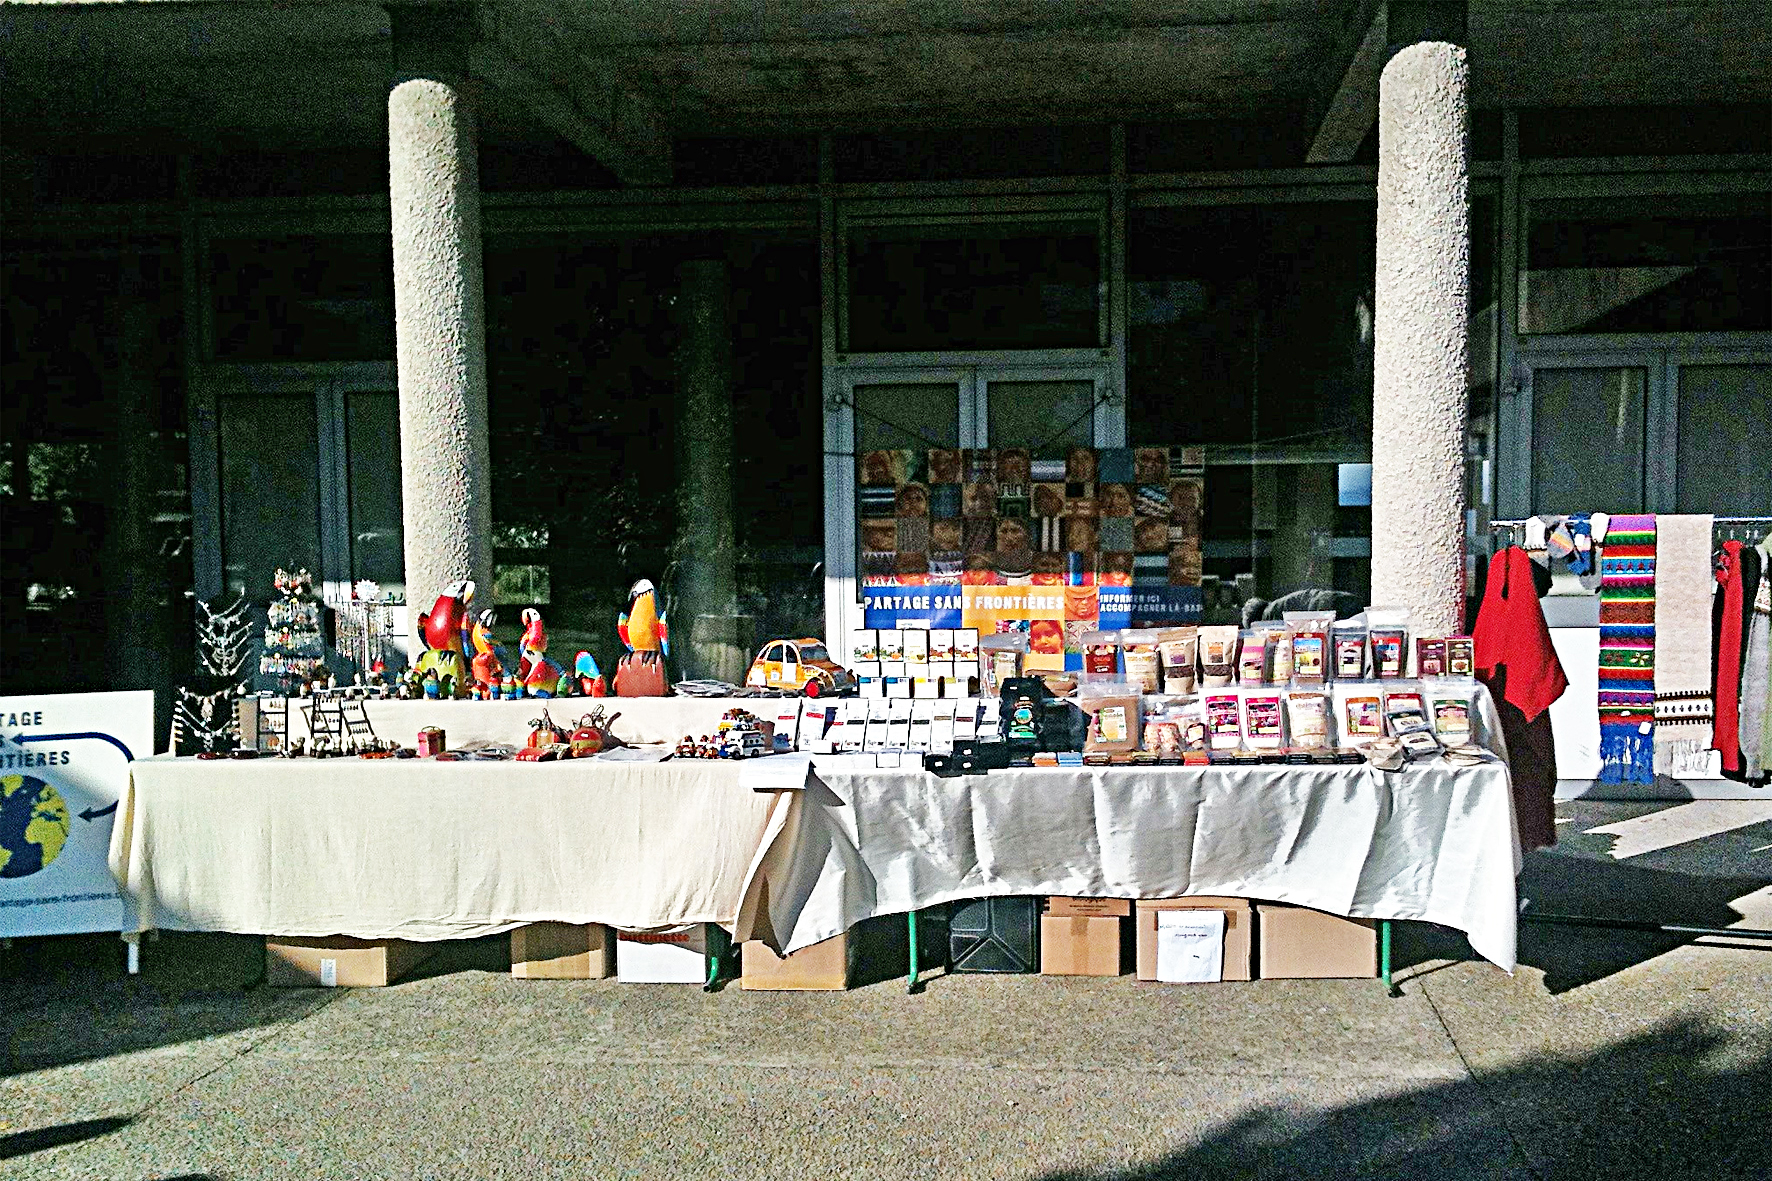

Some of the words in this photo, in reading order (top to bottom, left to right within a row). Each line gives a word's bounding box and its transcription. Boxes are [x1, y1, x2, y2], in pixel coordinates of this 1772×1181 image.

[863, 595, 930, 610] PARTAGE
[934, 595, 971, 610] SANS
[975, 592, 1065, 610] FRONTIÈRES
[1099, 594, 1145, 603] INFORMER
[1099, 603, 1166, 612] ACCOMPAGNER
